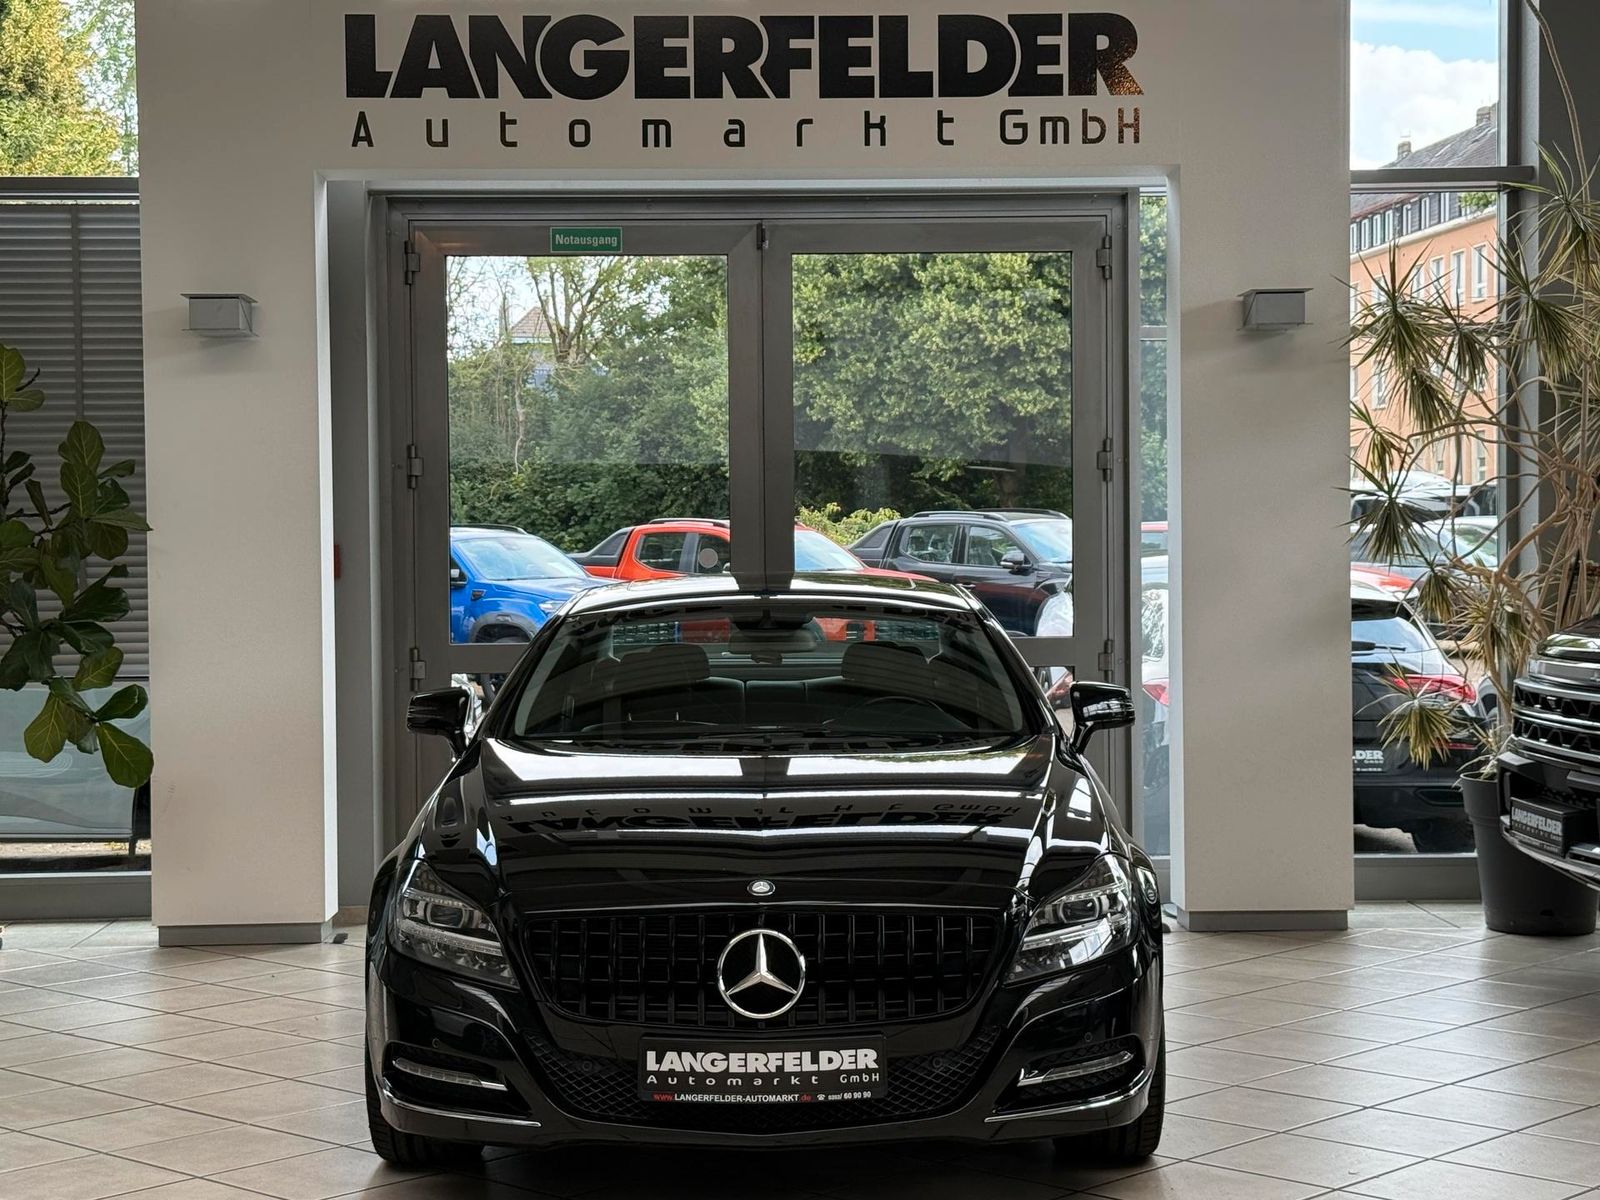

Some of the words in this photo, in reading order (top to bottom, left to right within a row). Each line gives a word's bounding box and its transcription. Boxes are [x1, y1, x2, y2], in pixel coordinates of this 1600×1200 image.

[345, 13, 1145, 100] LANGERFELDER
[351, 110, 956, 148] Automarkt
[1000, 108, 1141, 145] GmbH
[555, 234, 618, 247] Notausgang
[646, 1048, 879, 1073] LANGERFELDER
[646, 1074, 819, 1086] Automarkt
[839, 1072, 880, 1084] GmbH
